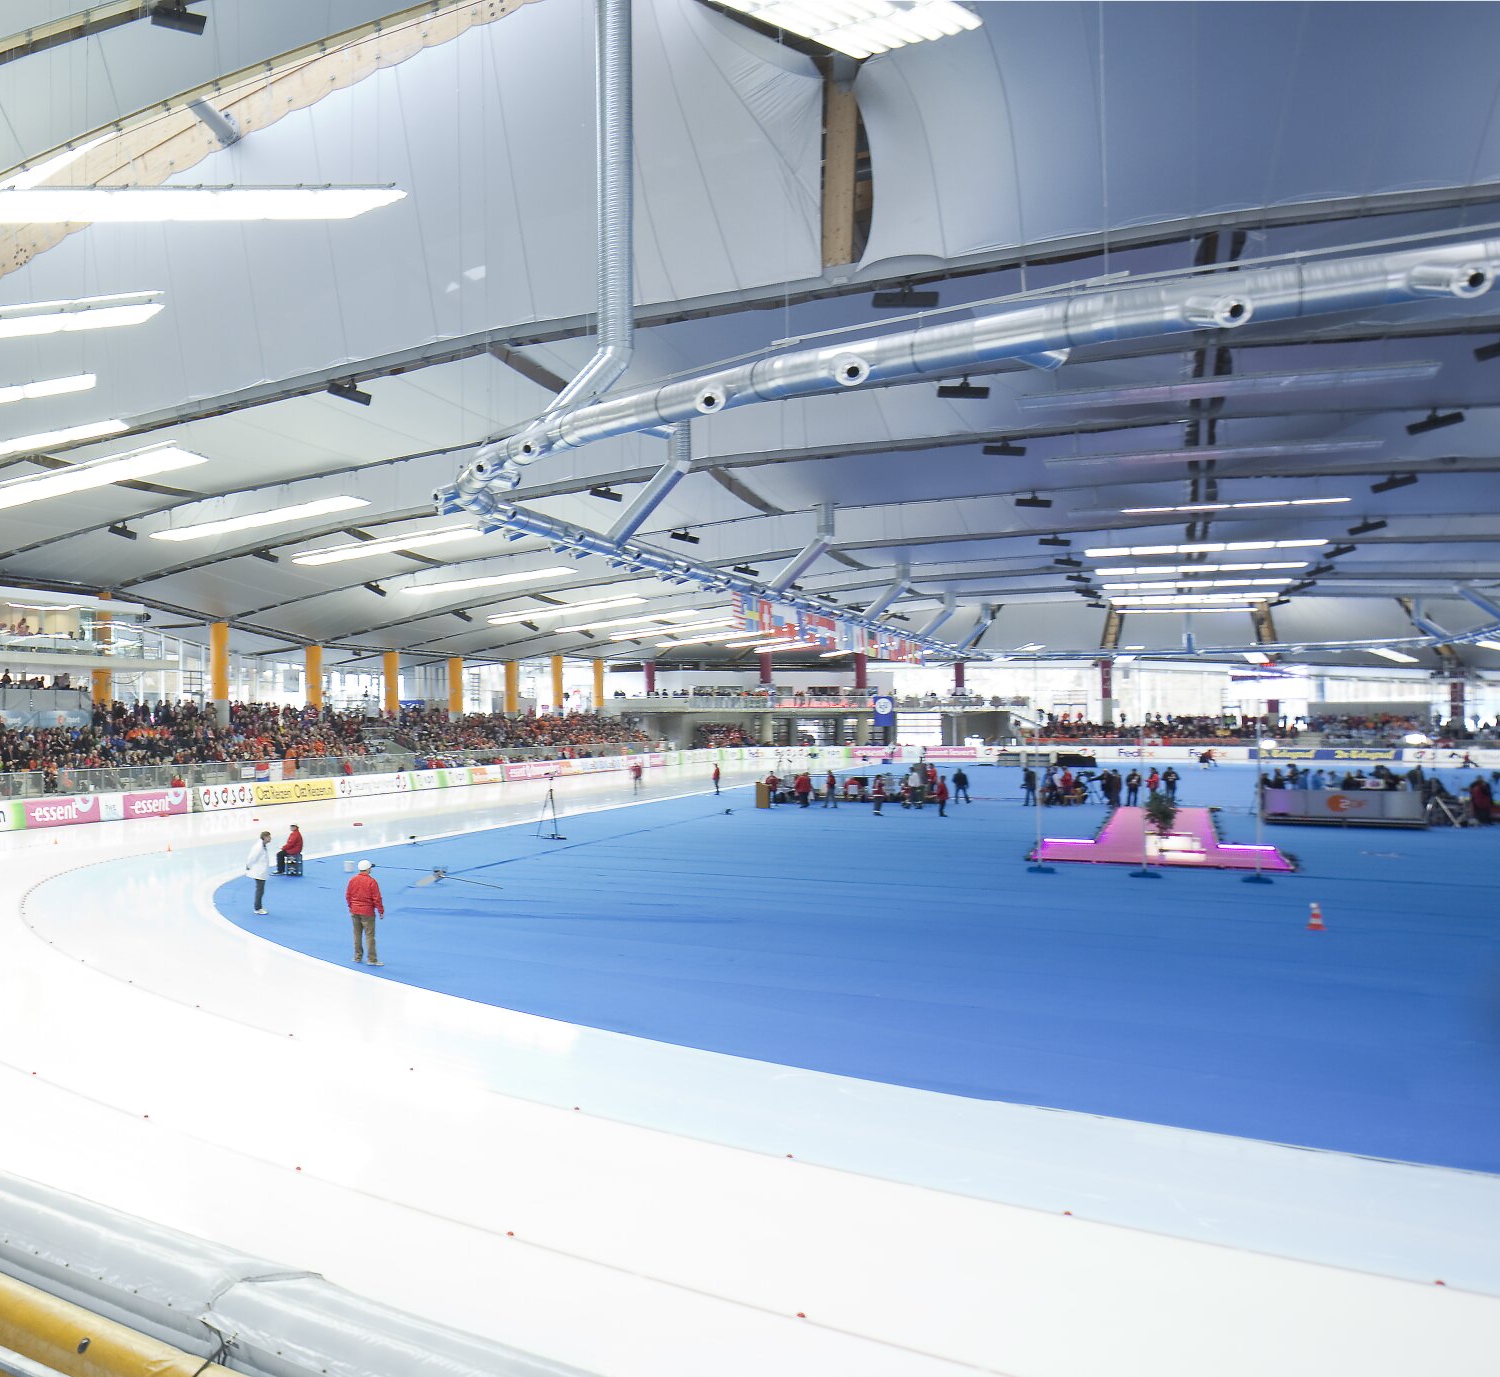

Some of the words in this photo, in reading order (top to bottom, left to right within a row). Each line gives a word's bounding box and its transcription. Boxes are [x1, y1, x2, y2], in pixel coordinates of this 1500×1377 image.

[1118, 749, 1155, 758] FedEx
[30, 801, 79, 822] essent
[130, 794, 172, 815] essent
